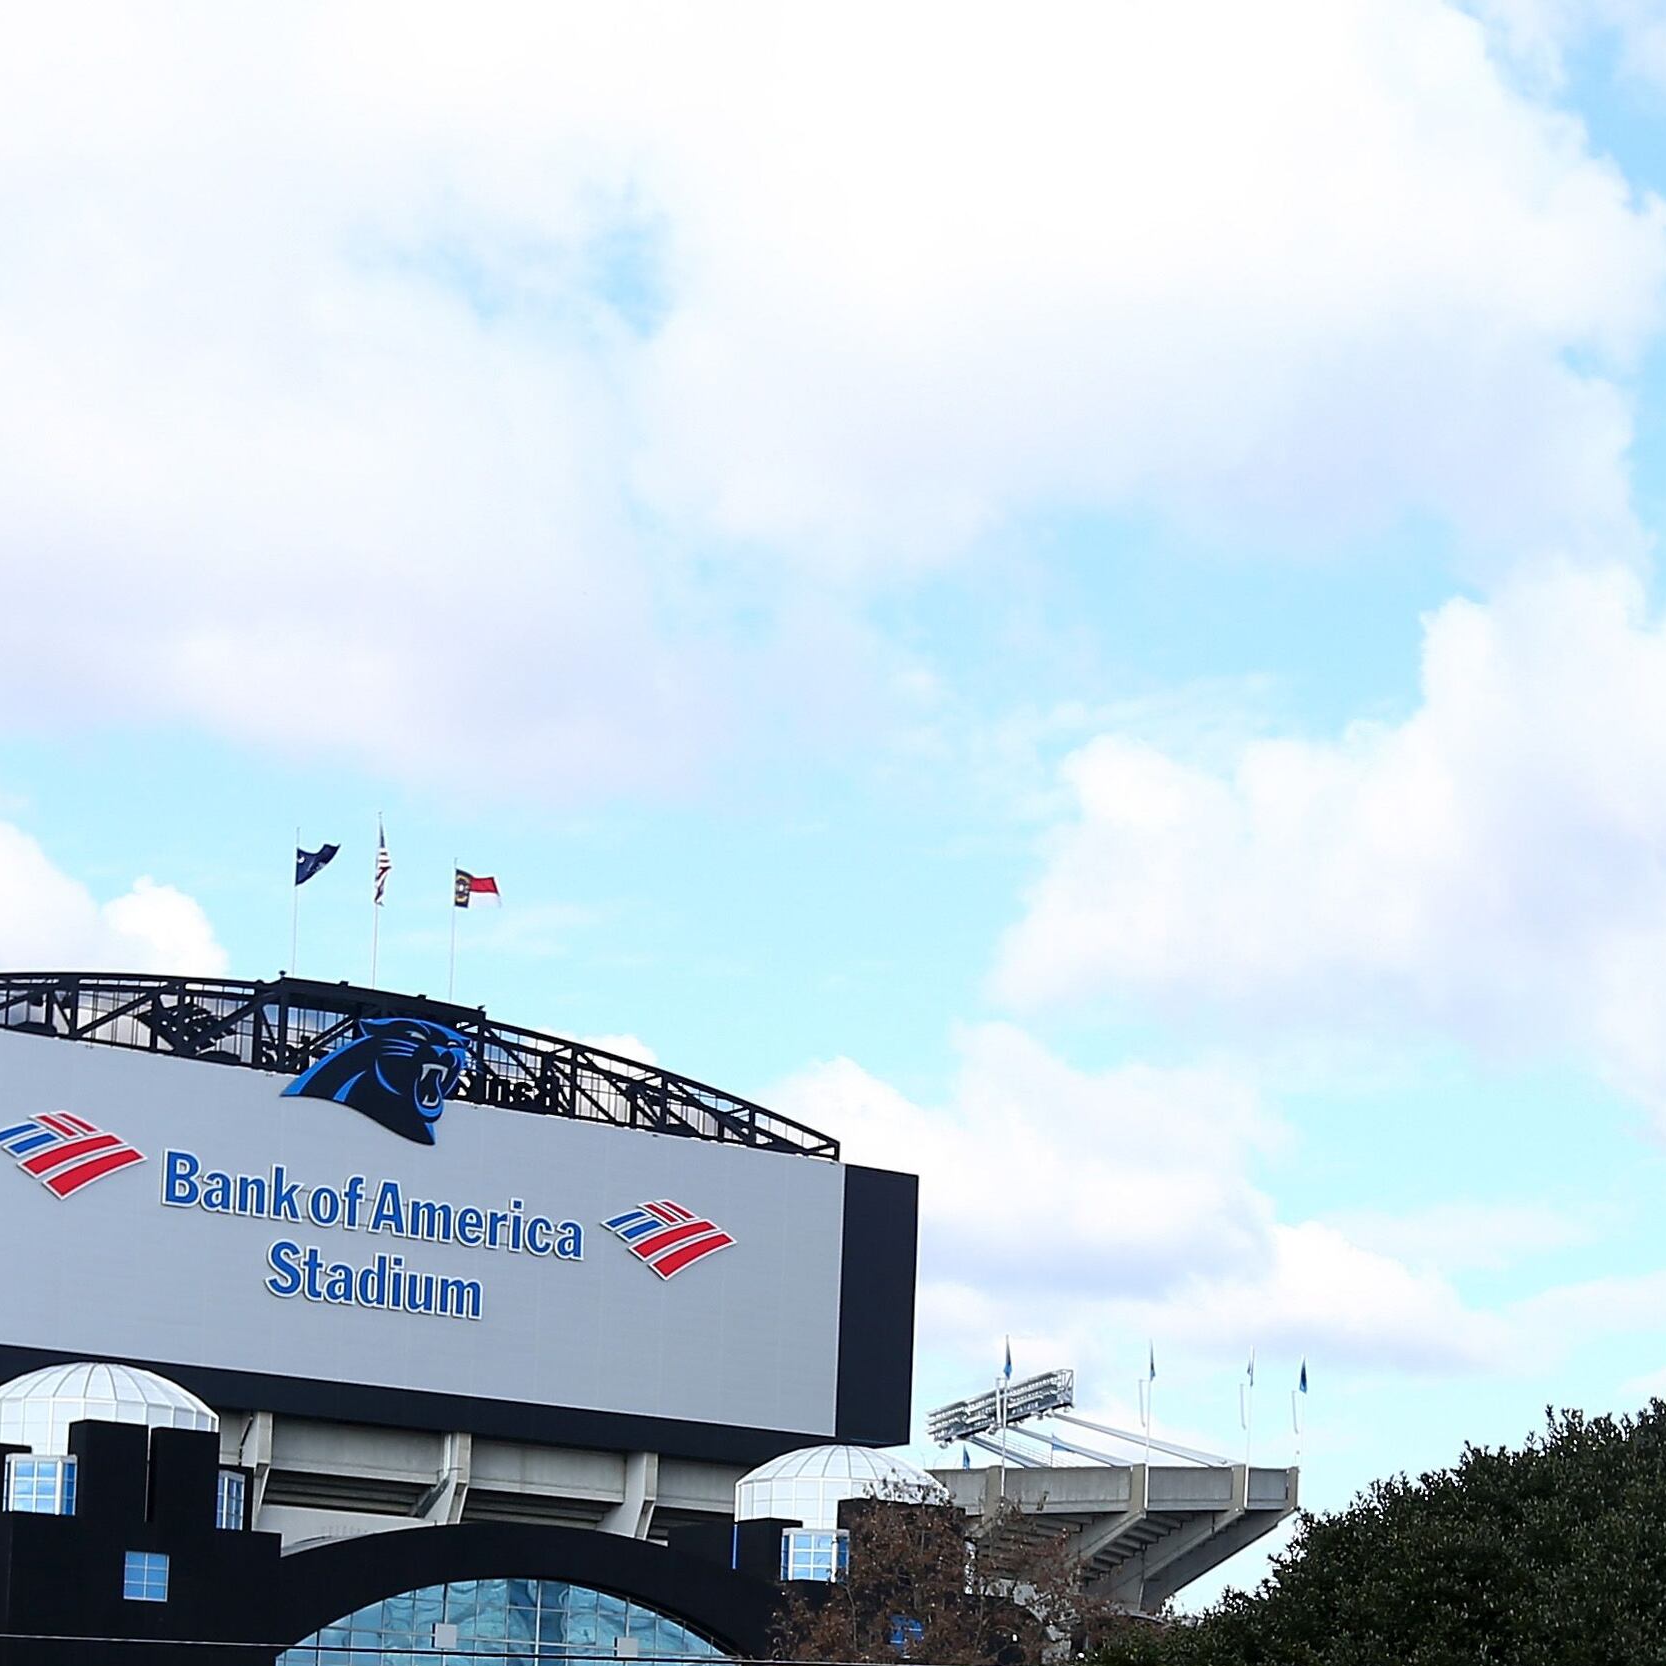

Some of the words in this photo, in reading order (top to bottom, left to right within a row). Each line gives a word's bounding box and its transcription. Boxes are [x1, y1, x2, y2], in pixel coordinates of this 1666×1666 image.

[162, 1148, 303, 1222] Bank
[307, 1175, 366, 1230] of
[367, 1180, 586, 1261] America
[264, 1239, 484, 1320] Stadium
